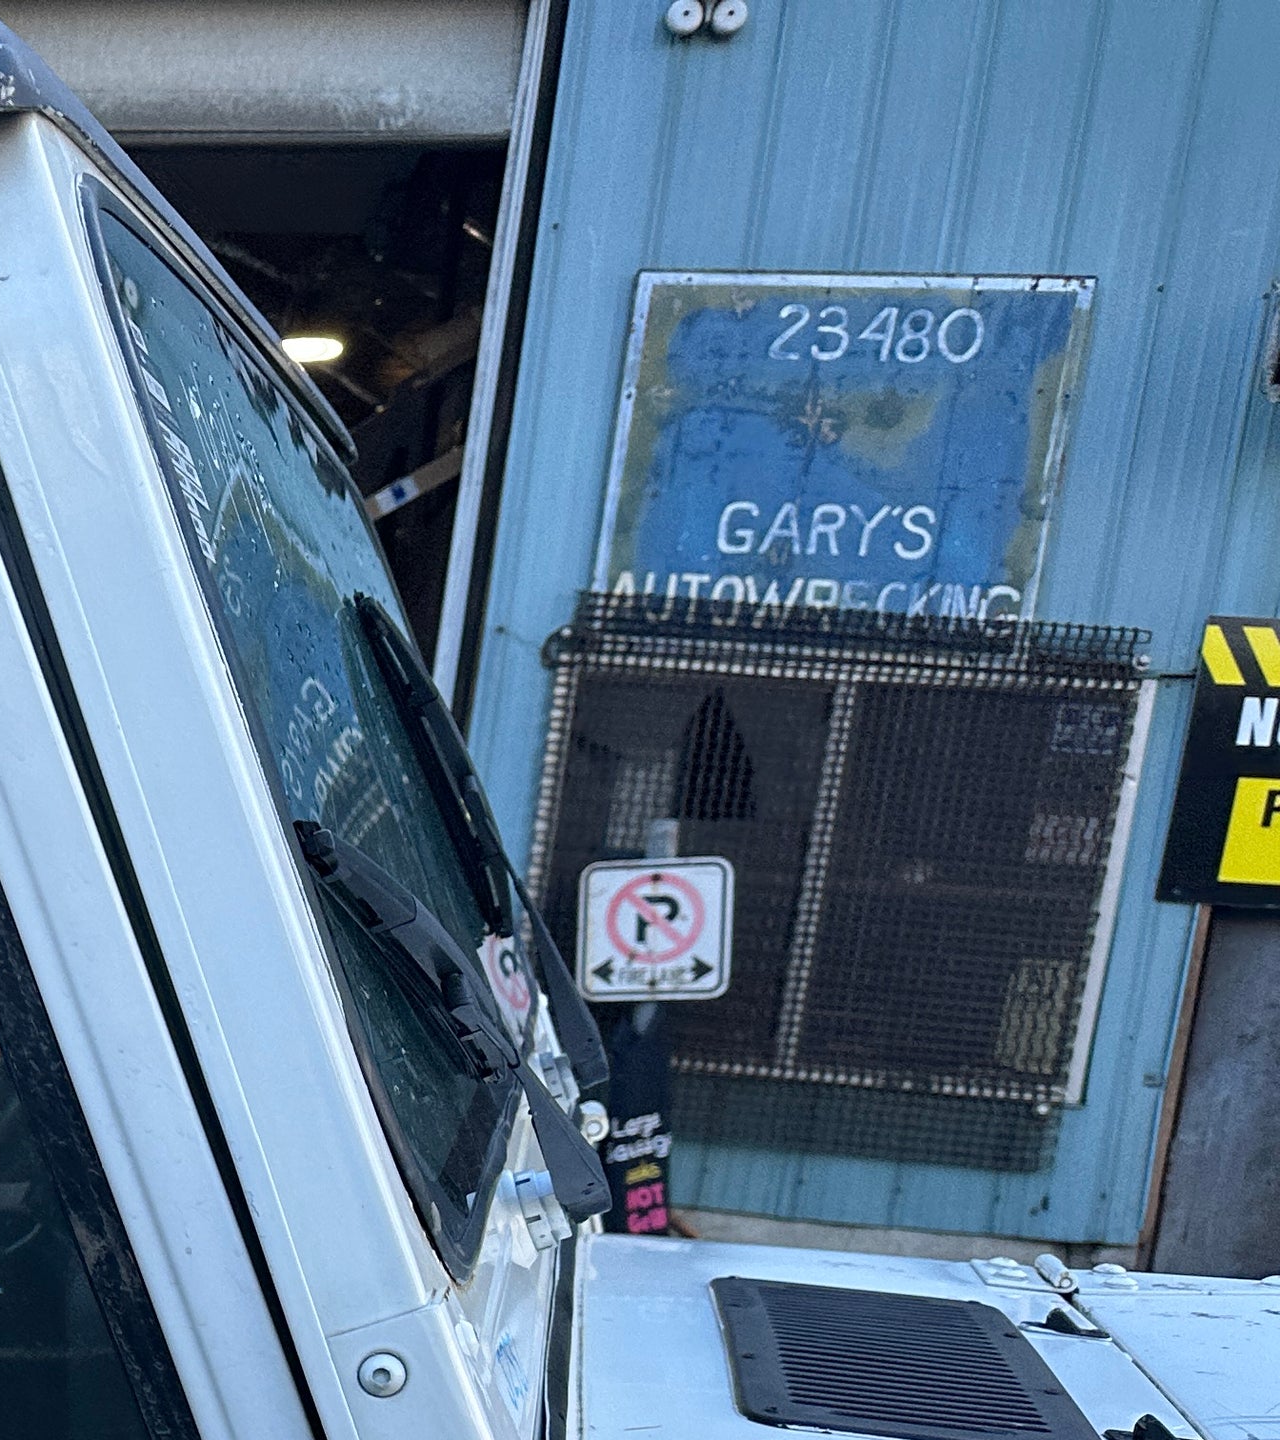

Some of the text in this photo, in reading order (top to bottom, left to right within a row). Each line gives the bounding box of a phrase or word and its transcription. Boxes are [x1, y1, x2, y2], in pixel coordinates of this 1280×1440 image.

[767, 303, 985, 364] 23480
[716, 500, 936, 561] GARY'S
[1235, 695, 1280, 748] N
